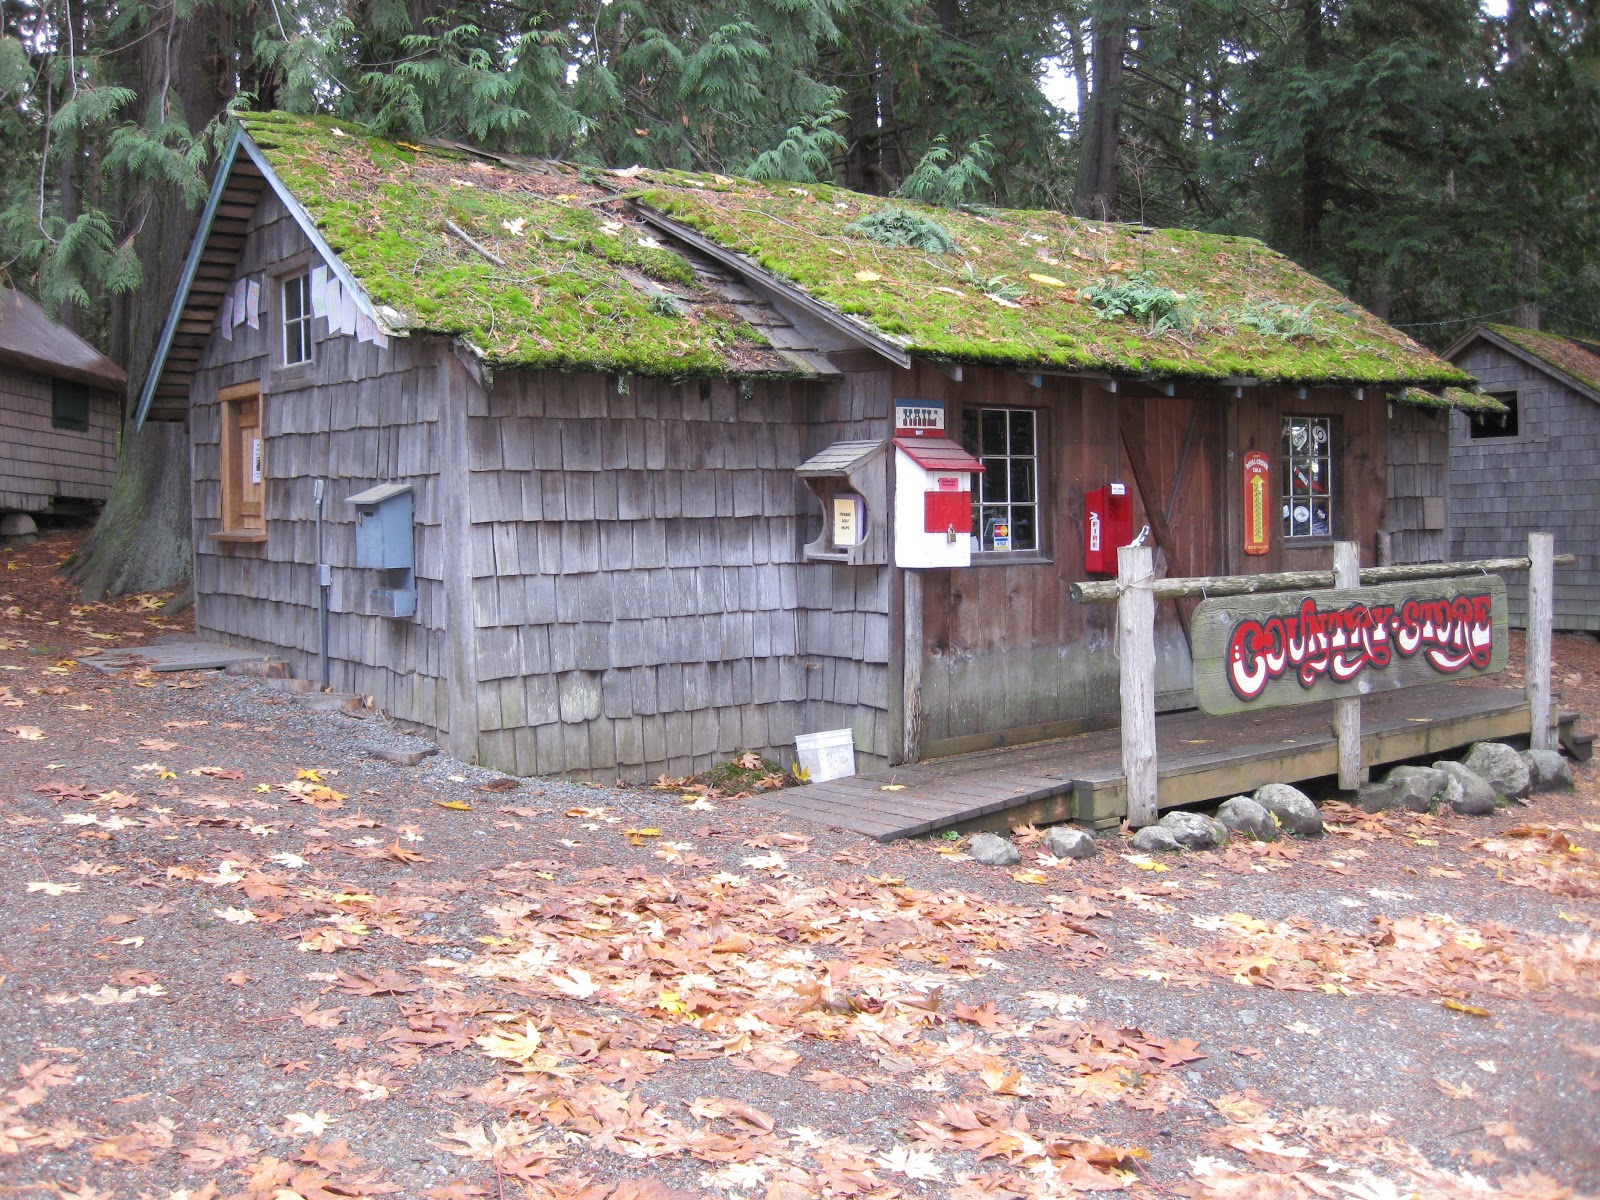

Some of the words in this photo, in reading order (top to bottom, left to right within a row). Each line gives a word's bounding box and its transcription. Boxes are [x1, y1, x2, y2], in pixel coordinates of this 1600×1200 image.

[903, 409, 936, 426] MAIL
[1226, 597, 1394, 701] COUNTRY
[1396, 593, 1491, 673] STORE
